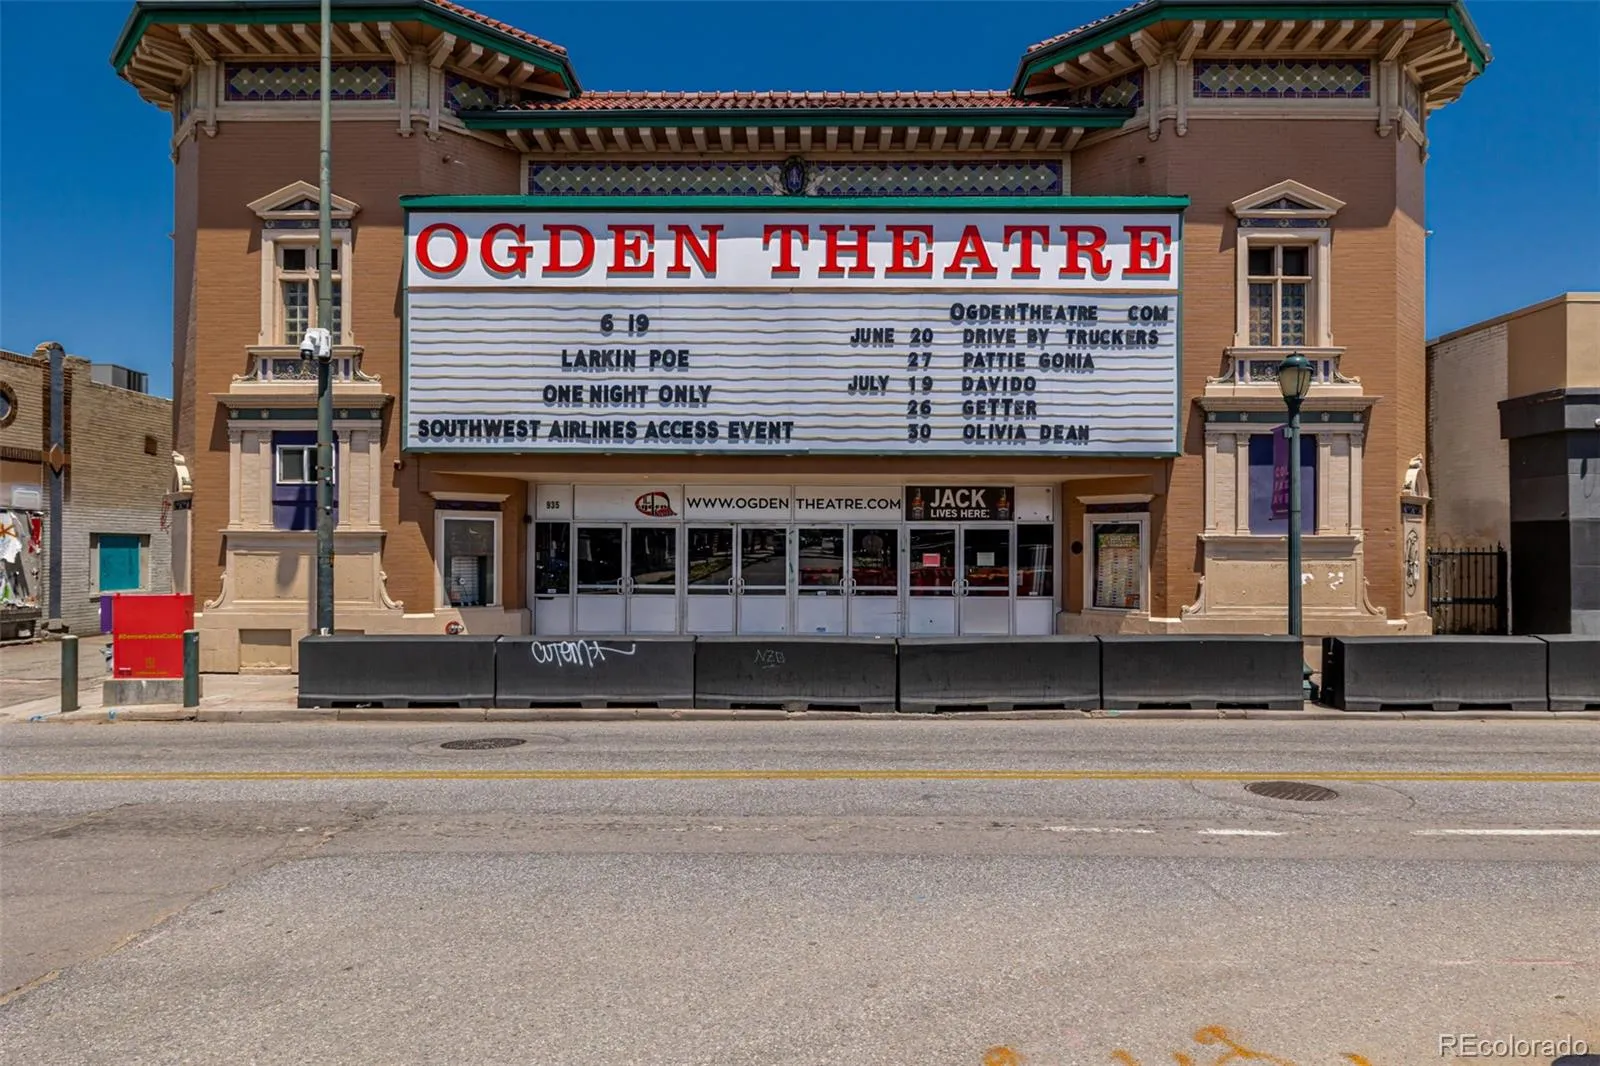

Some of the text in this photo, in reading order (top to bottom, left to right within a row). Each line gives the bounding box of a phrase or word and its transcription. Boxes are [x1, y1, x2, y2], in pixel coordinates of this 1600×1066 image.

[415, 223, 1172, 276] OGDEN THEATRE
[1128, 305, 1168, 321] COM
[600, 314, 650, 332] 6 19
[850, 328, 1159, 345] JUNE 20 DRIVE BY TRUCKERS
[561, 350, 690, 368] LARKIN POE
[908, 352, 1095, 369] 27 PATTIE GONIA
[848, 375, 1037, 392] JULY 19 DAVIDO
[542, 385, 712, 403] ONE NIGHT ONLY
[907, 399, 1037, 416] 26 GETTER
[418, 419, 794, 439] SOUTHWEST AIRLINES ACCESS EVENT
[908, 424, 1090, 441] 30 OLIVIA DEAN
[686, 497, 904, 510] WWW.OGDEN THEATRE.COM
[930, 488, 986, 508] JACK
[930, 509, 958, 518] LIVES
